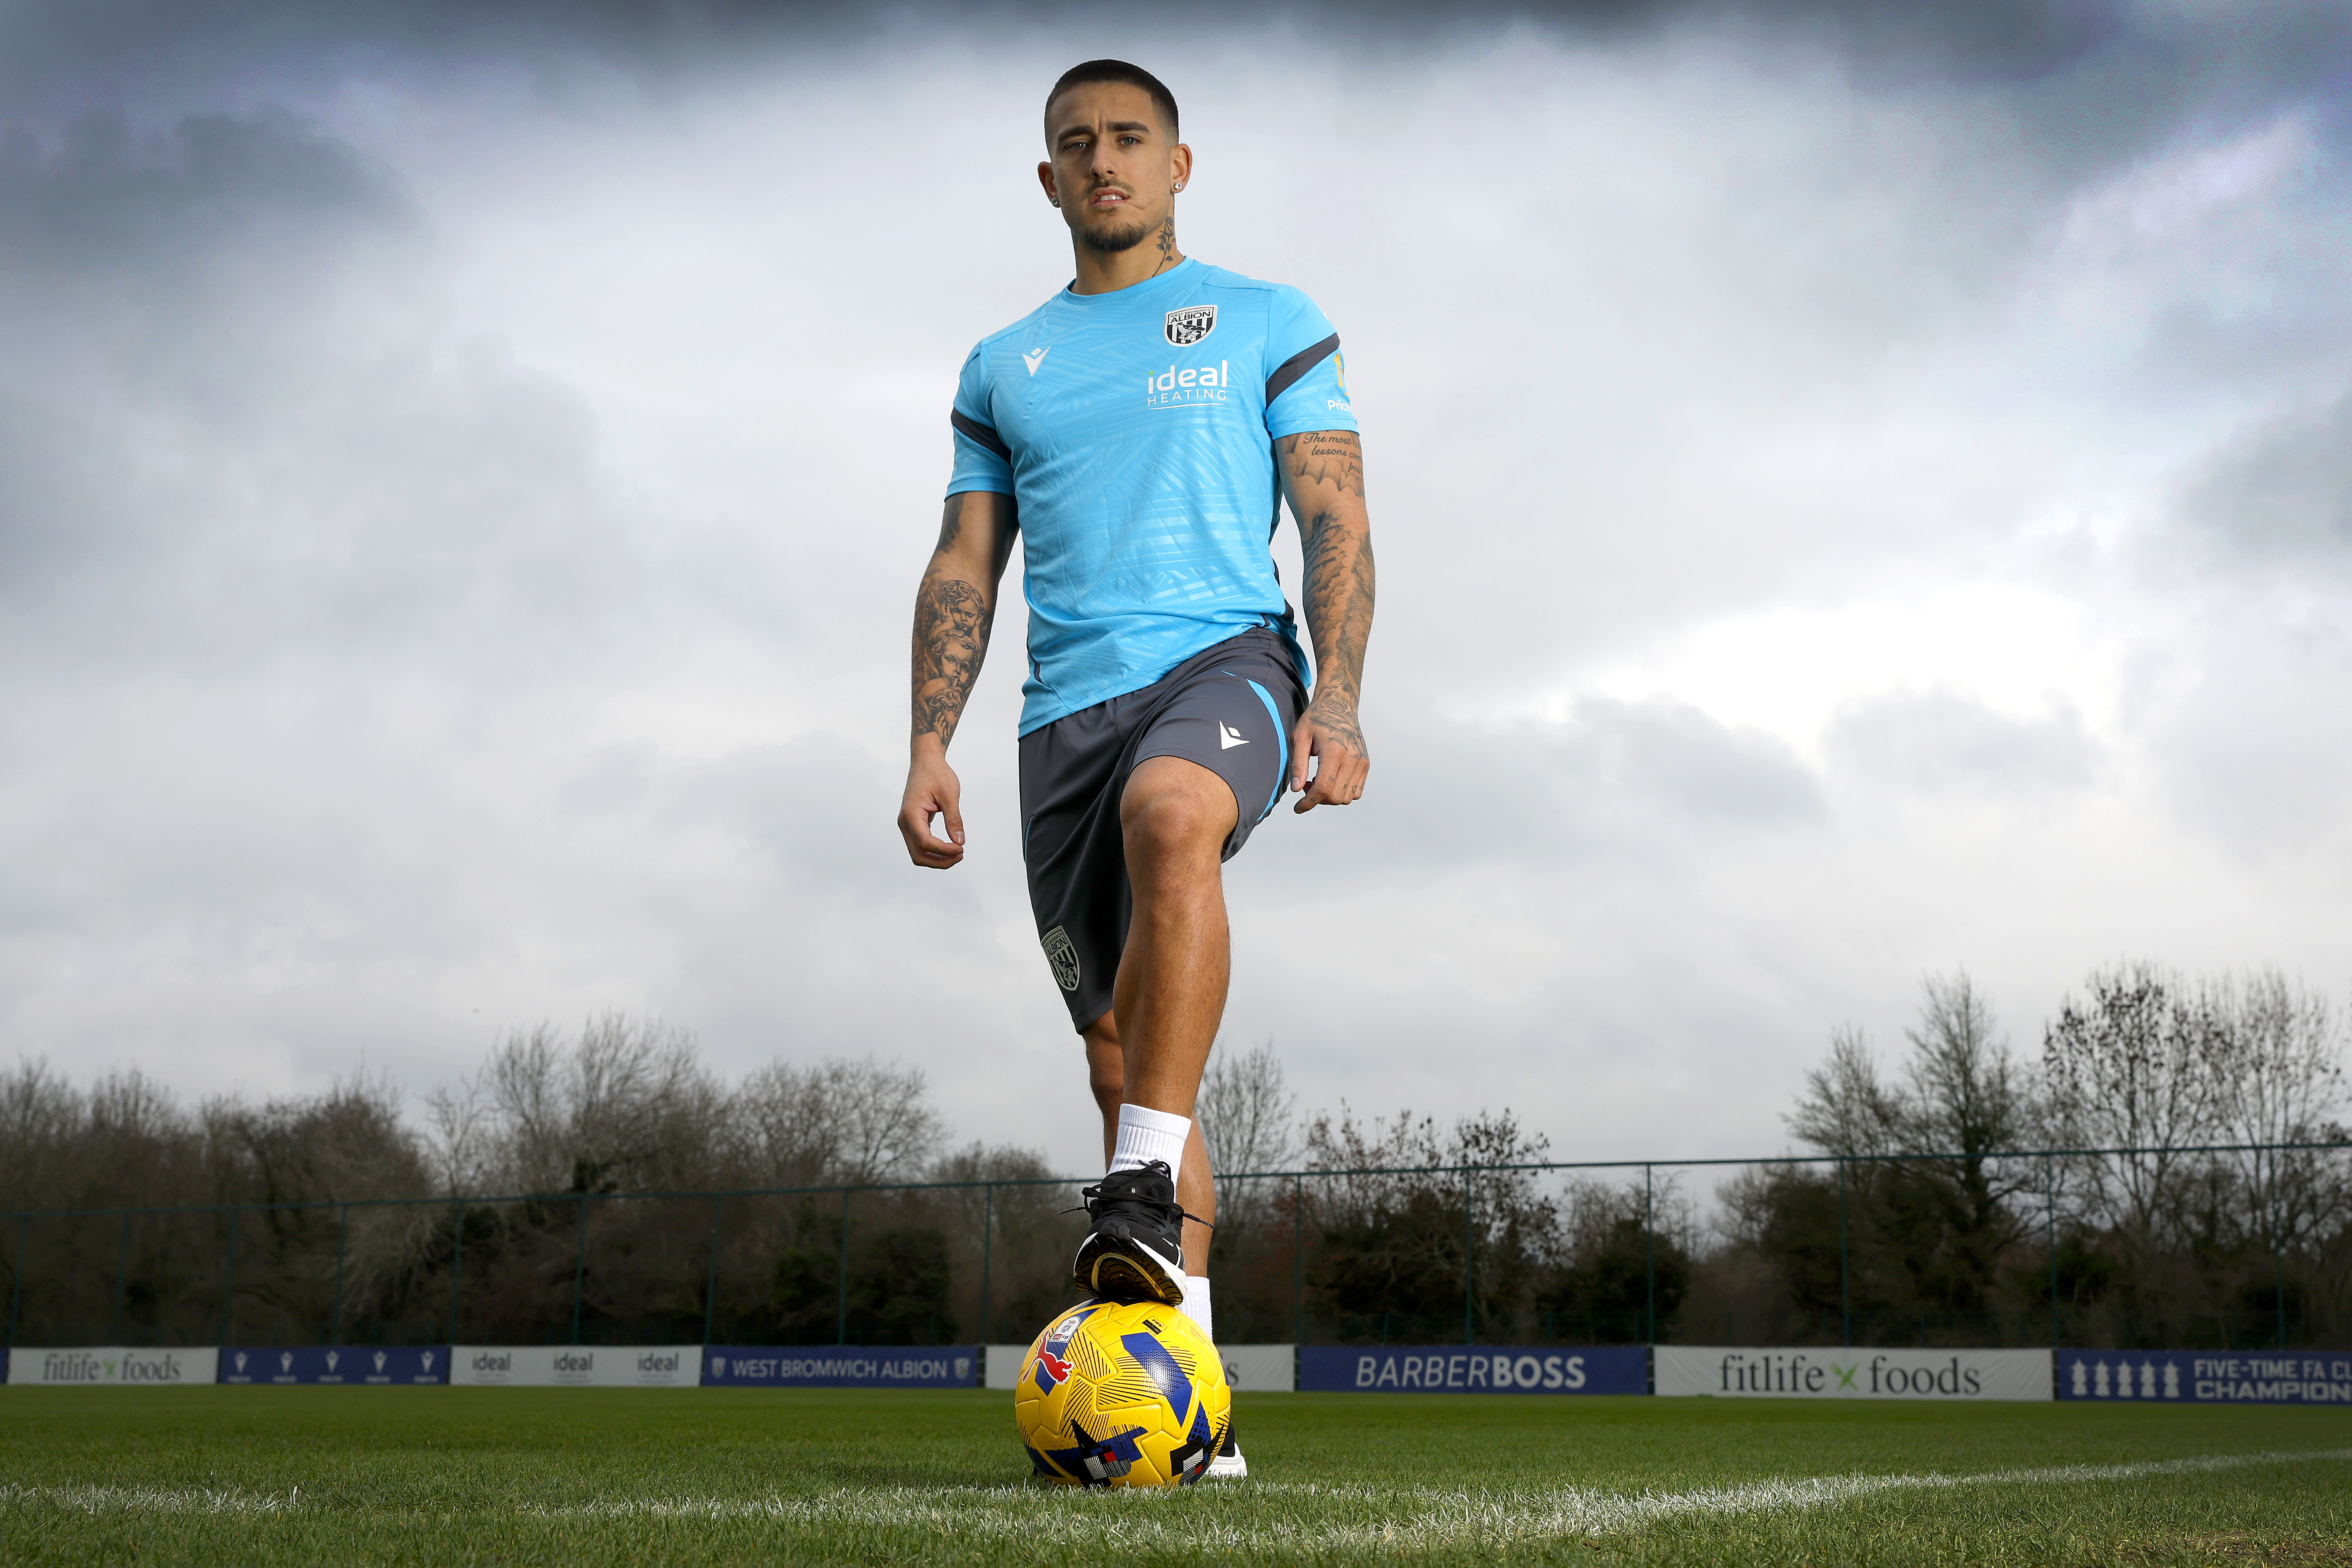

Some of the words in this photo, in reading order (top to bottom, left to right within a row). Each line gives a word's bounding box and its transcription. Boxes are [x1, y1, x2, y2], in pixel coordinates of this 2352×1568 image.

[1170, 311, 1211, 324] ALBION
[1148, 360, 1228, 394] ideal
[1148, 389, 1227, 406] HEATING
[1303, 433, 1327, 444] The
[1329, 437, 1352, 445] most
[1311, 445, 1347, 456] lessons
[1047, 936, 1067, 958] ALBION
[43, 1353, 100, 1382] fitlife
[122, 1354, 181, 1382] foods
[472, 1352, 511, 1371] ideal
[553, 1352, 593, 1371] ideal
[637, 1352, 679, 1372] ideal
[732, 1359, 778, 1378] WEST
[781, 1359, 877, 1378] BROMWICH
[880, 1359, 948, 1378] ALBION
[2194, 1359, 2298, 1379] FIVE-TIME
[2302, 1359, 2327, 1380] FA
[1355, 1355, 1587, 1389] BARBERBOSS
[1719, 1354, 1825, 1392] fitlife
[1869, 1355, 1981, 1396] foods
